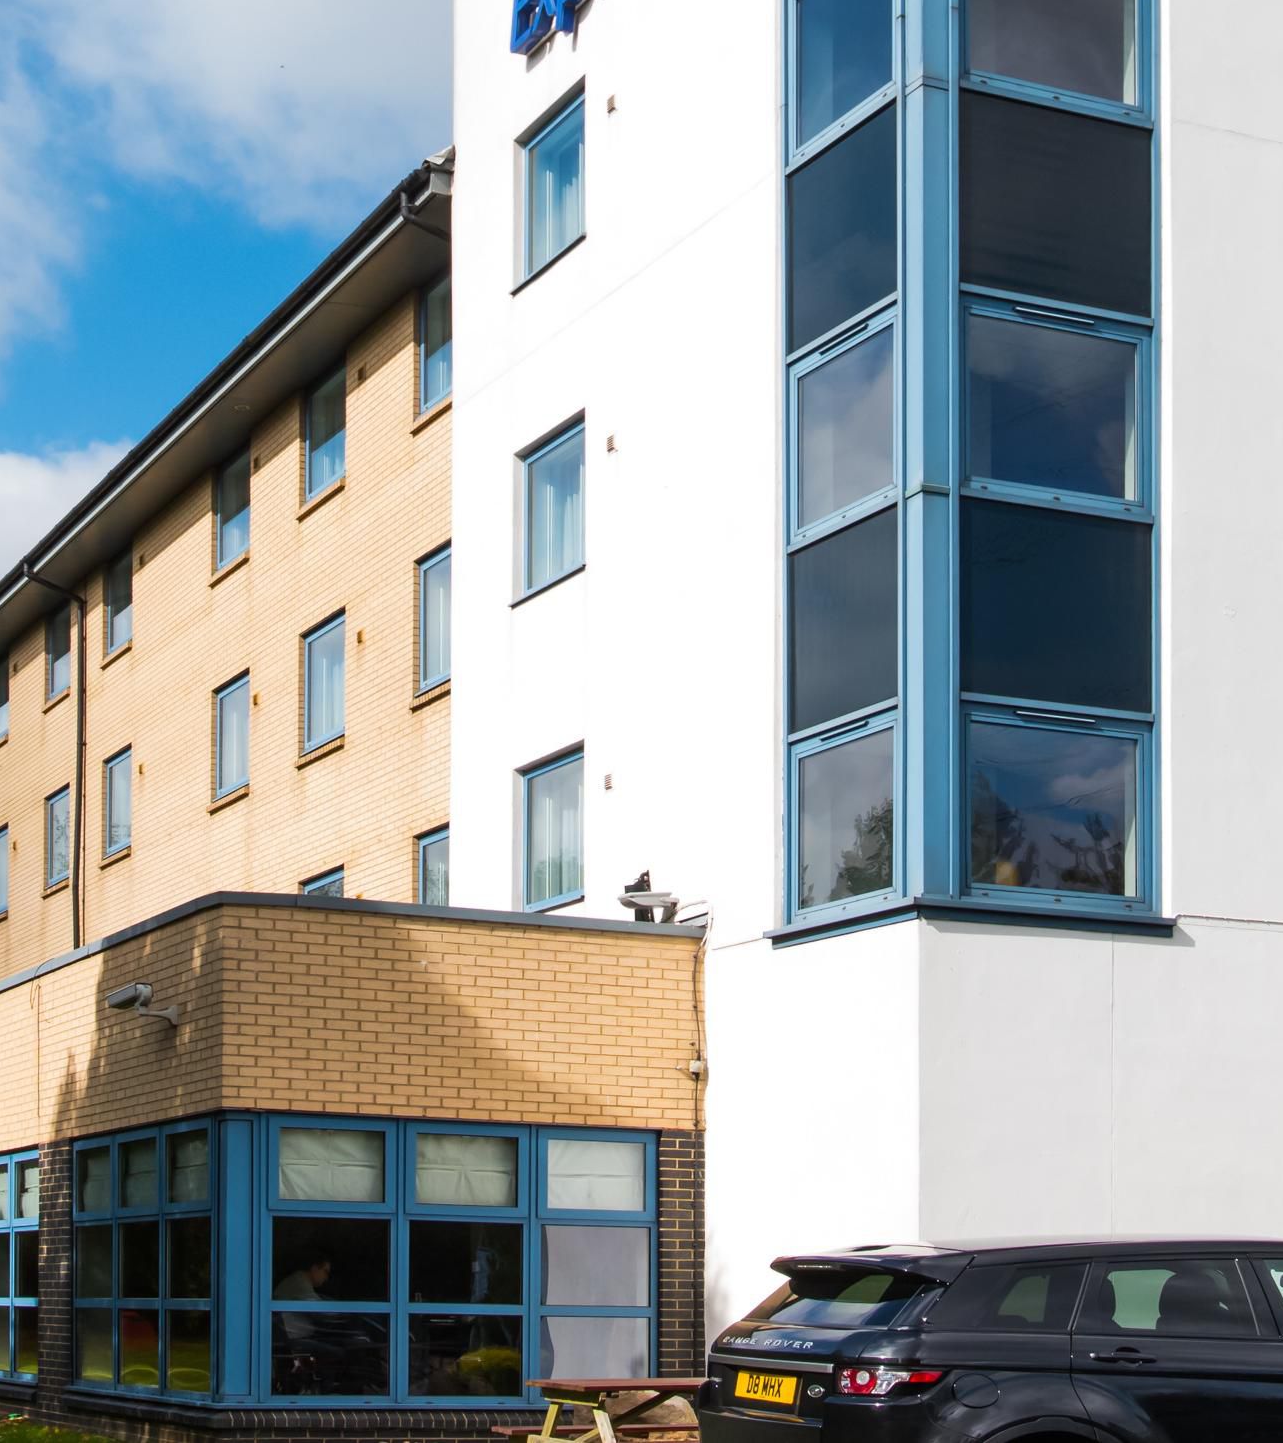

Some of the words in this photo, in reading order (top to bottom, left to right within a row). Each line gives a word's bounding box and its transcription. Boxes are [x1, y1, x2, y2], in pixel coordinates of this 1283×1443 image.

[722, 1336, 758, 1345] RANGE
[764, 1339, 814, 1349] ROVER
[746, 1375, 761, 1395] D8
[761, 1376, 784, 1398] MHX
